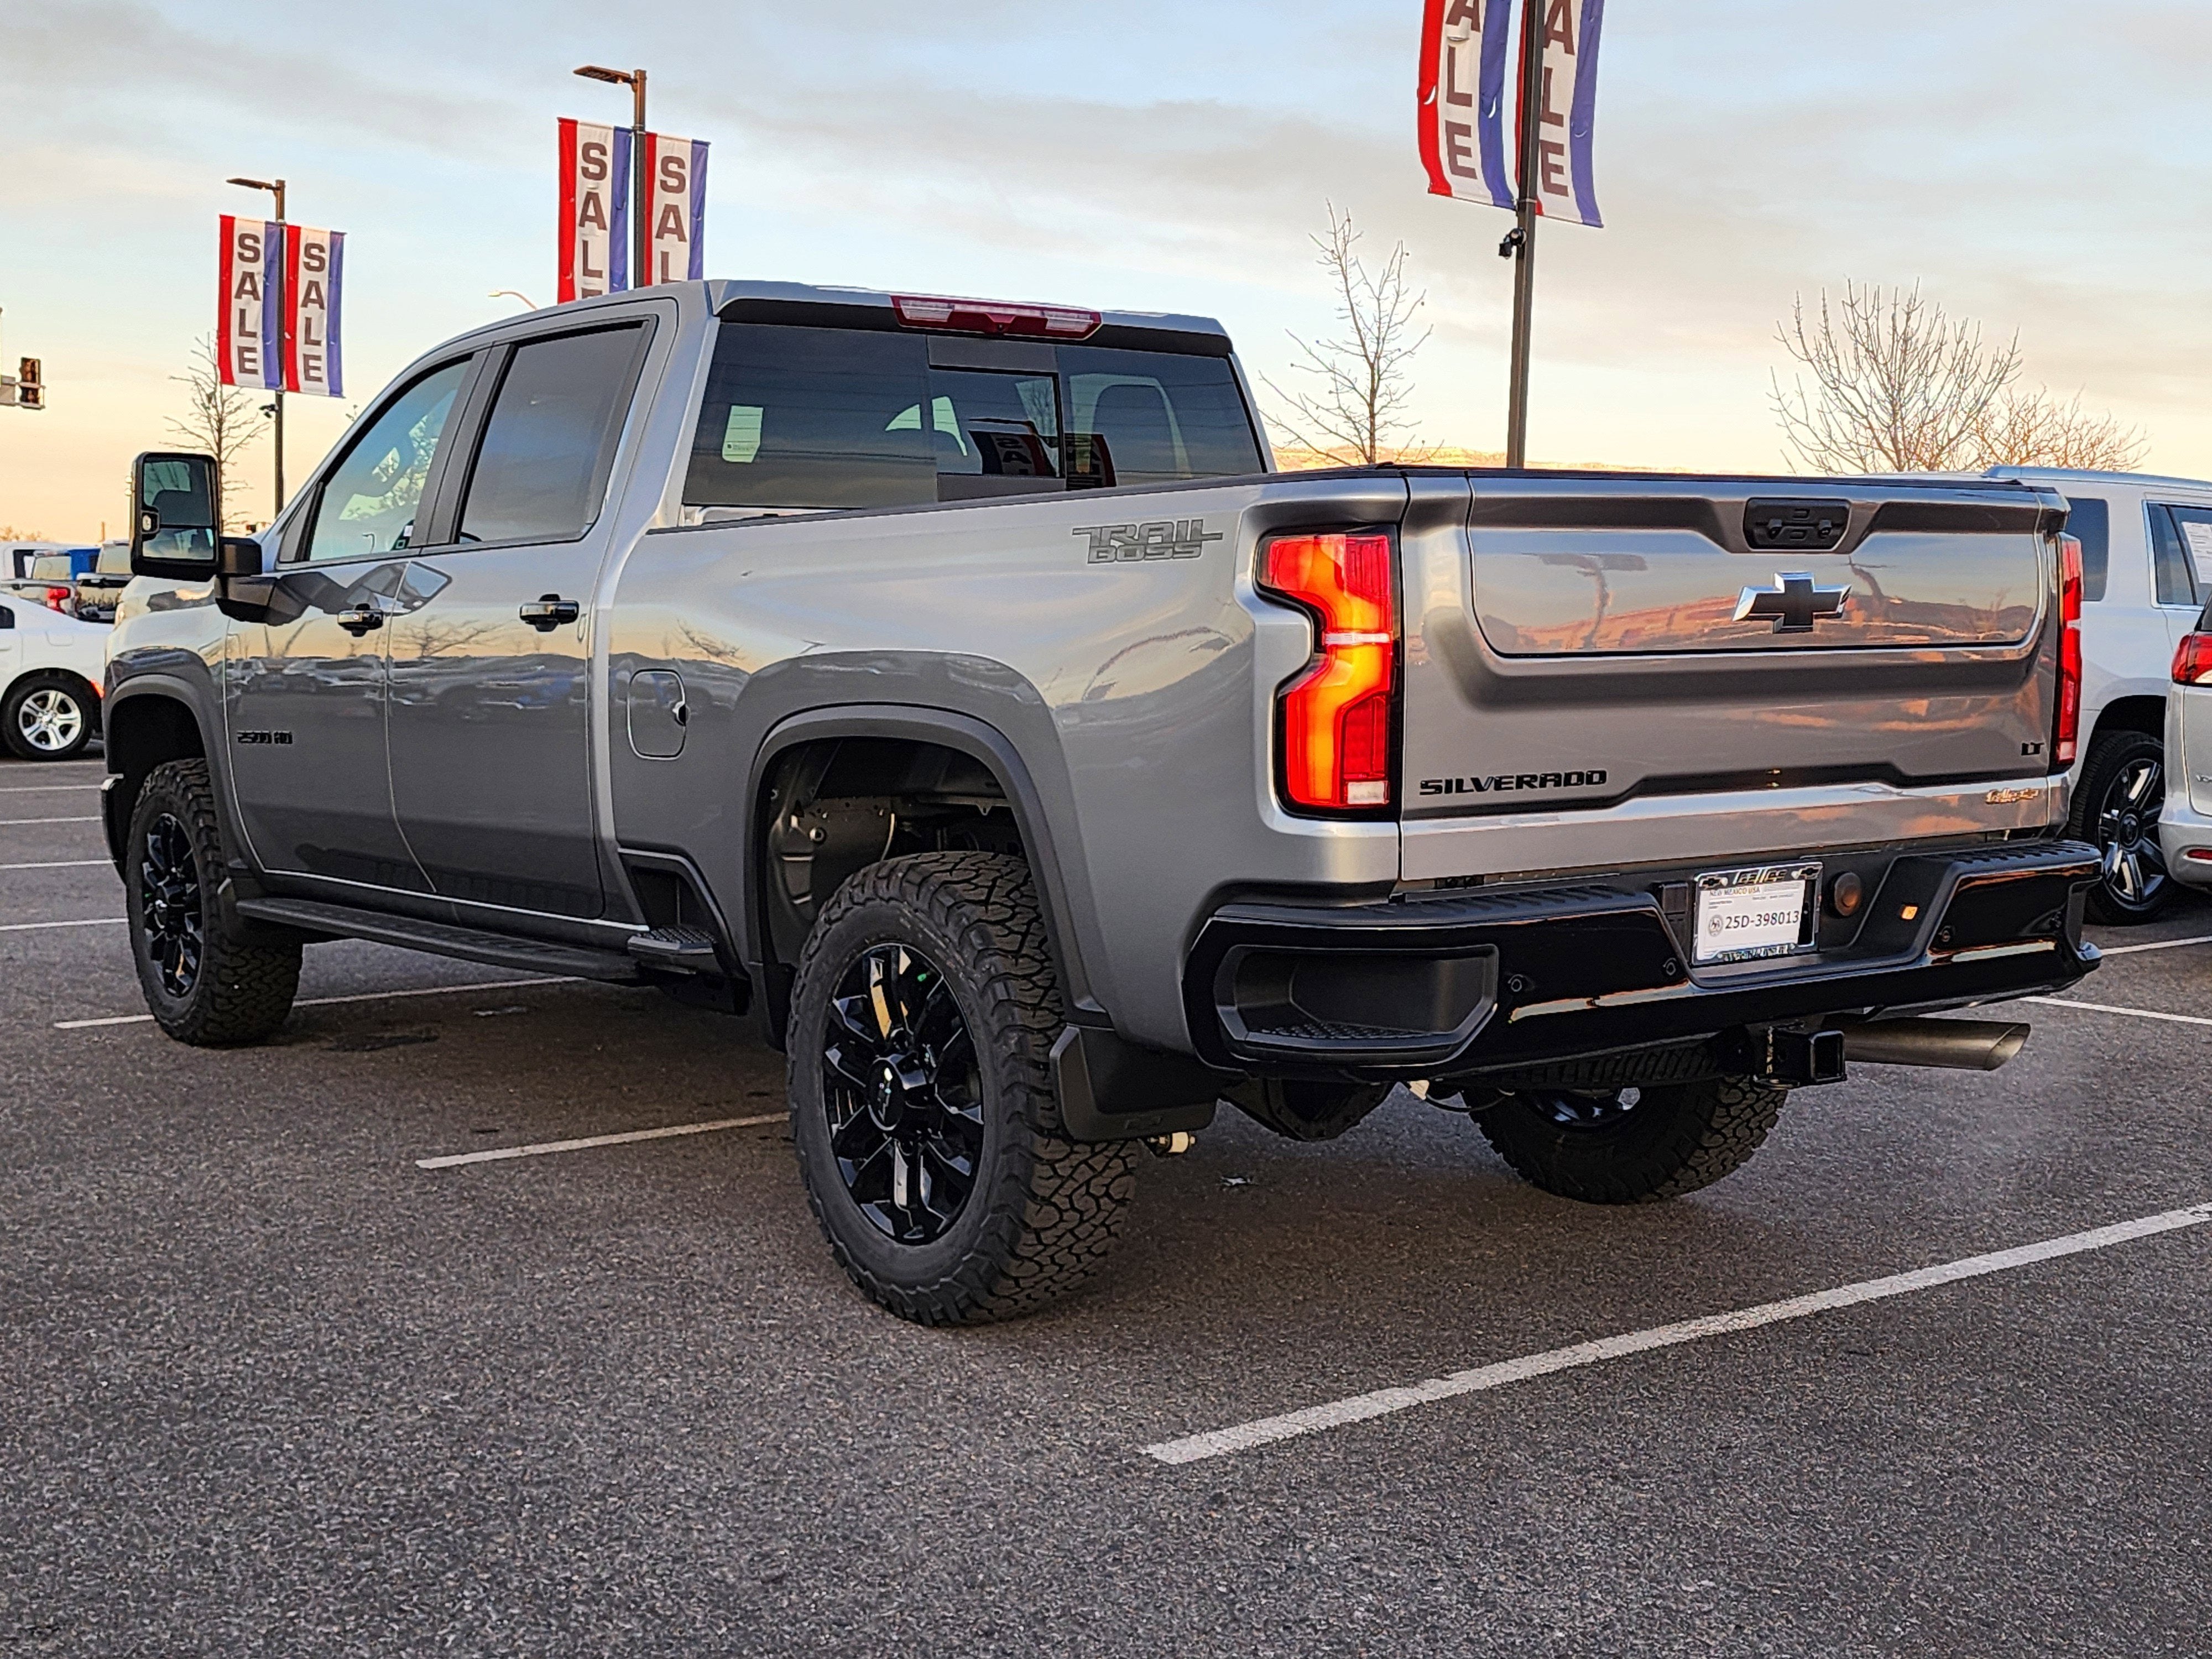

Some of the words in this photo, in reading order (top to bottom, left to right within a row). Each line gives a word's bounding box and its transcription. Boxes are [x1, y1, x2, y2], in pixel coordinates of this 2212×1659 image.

[1445, 0, 1480, 180] ALE
[1540, 0, 1575, 197] ALE
[655, 155, 687, 284] SAL
[234, 233, 260, 375] SALE
[301, 243, 325, 383] SALE
[1072, 519, 1223, 546] TRAIL
[1087, 541, 1203, 564] BOSS
[2021, 742, 2044, 755] LT
[1420, 770, 1607, 795] SILVERADO
[1748, 886, 1761, 894] USA
[1725, 910, 1800, 929] 25D-398013
